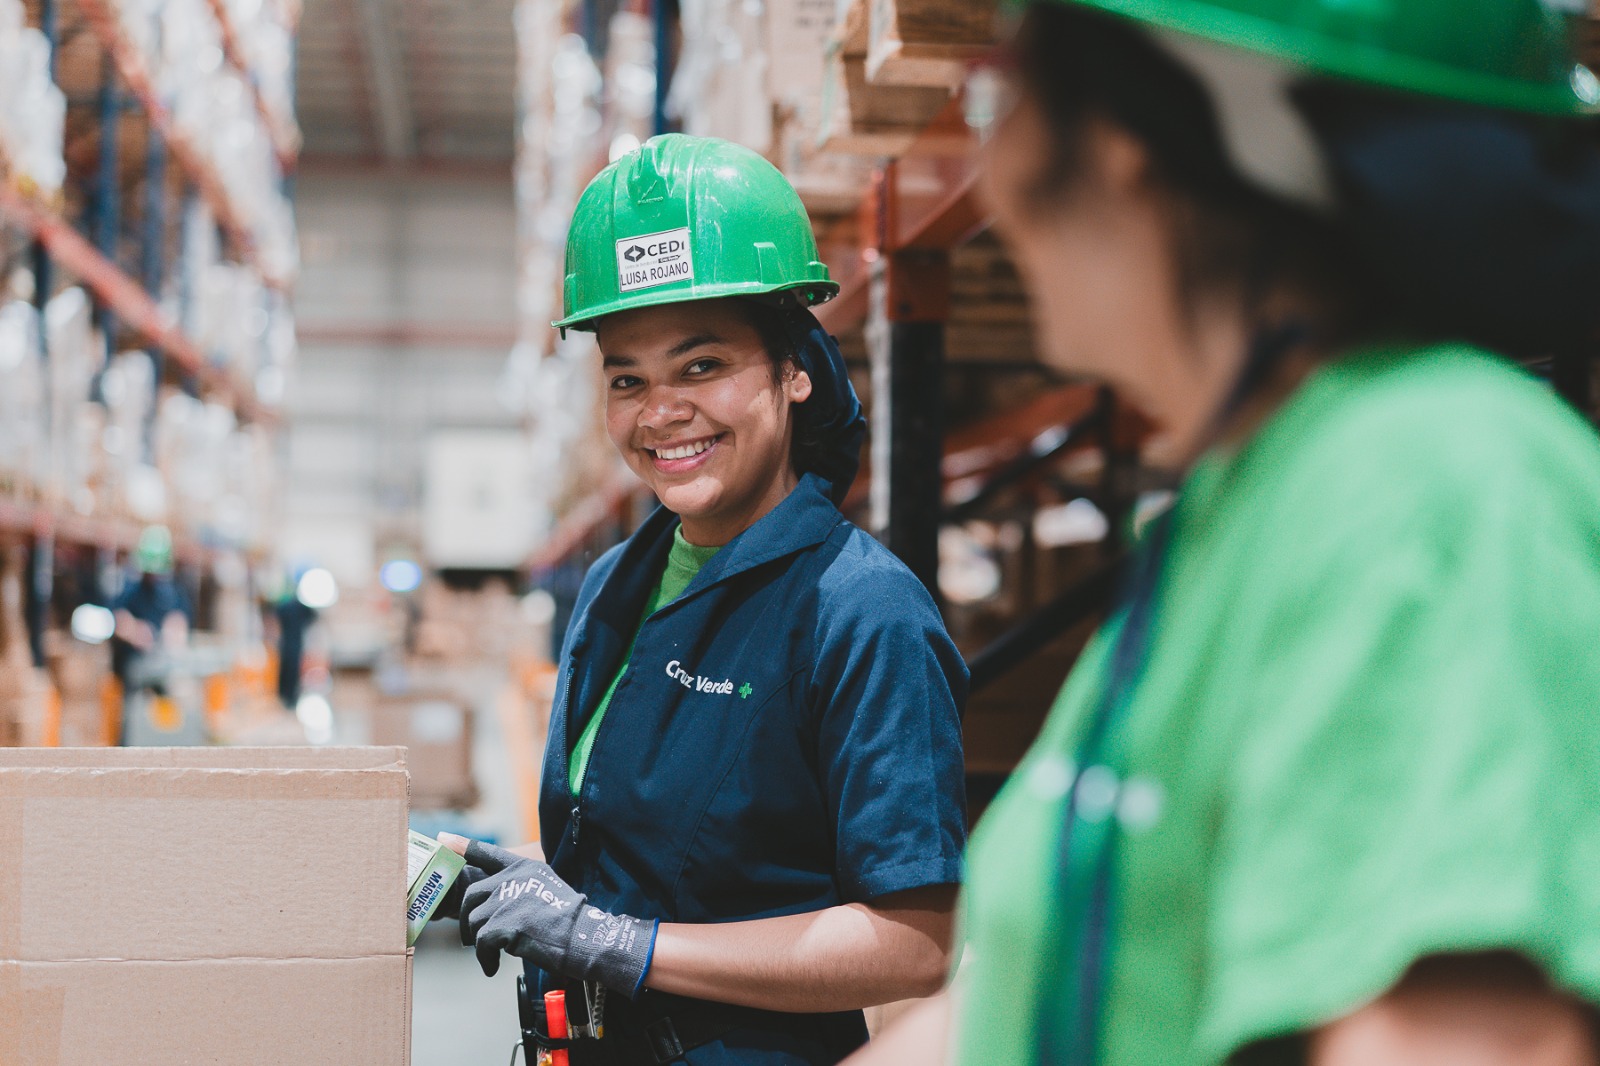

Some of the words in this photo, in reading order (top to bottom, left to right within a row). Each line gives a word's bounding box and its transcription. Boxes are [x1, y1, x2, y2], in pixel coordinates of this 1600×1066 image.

[620, 270, 648, 286] LUISA
[650, 261, 689, 281] ROJANO
[665, 660, 694, 688] Cruz
[695, 675, 734, 694] Verde
[407, 871, 442, 921] MAGNESIO
[499, 877, 565, 910] HyFlex
